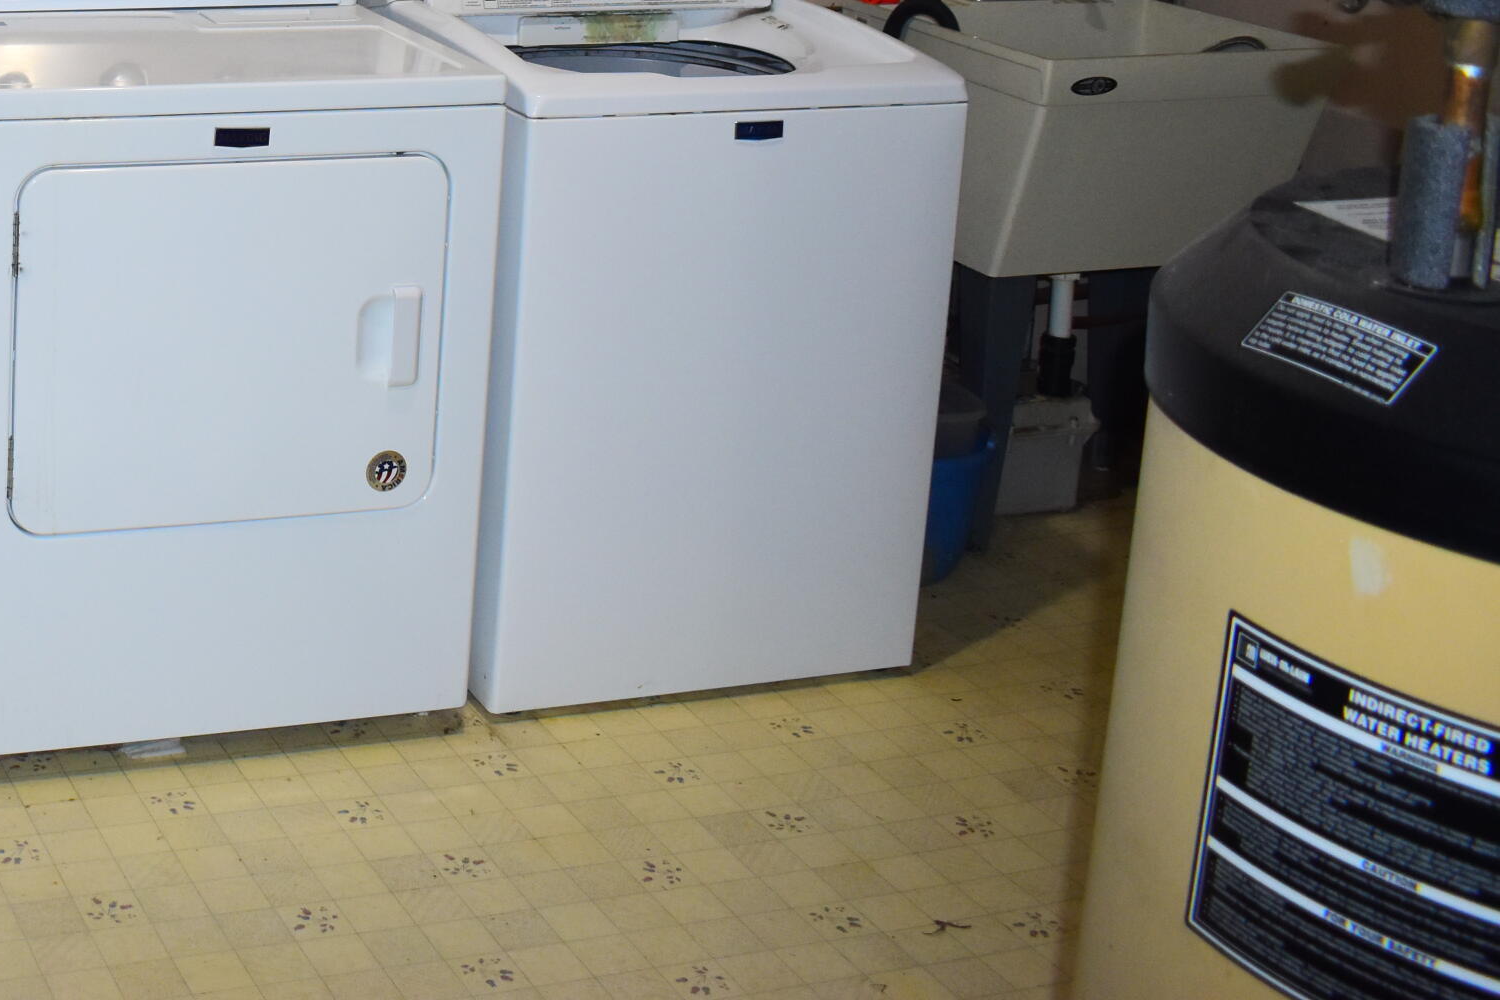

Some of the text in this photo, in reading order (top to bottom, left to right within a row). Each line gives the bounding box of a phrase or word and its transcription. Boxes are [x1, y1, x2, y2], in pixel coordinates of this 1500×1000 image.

[1333, 309, 1359, 326] COLD
[1358, 318, 1392, 338] WATER
[1390, 330, 1423, 351] INLET
[1343, 705, 1493, 776] WATER HEATERS
[1348, 688, 1493, 754] INDIRECT-FIRED
